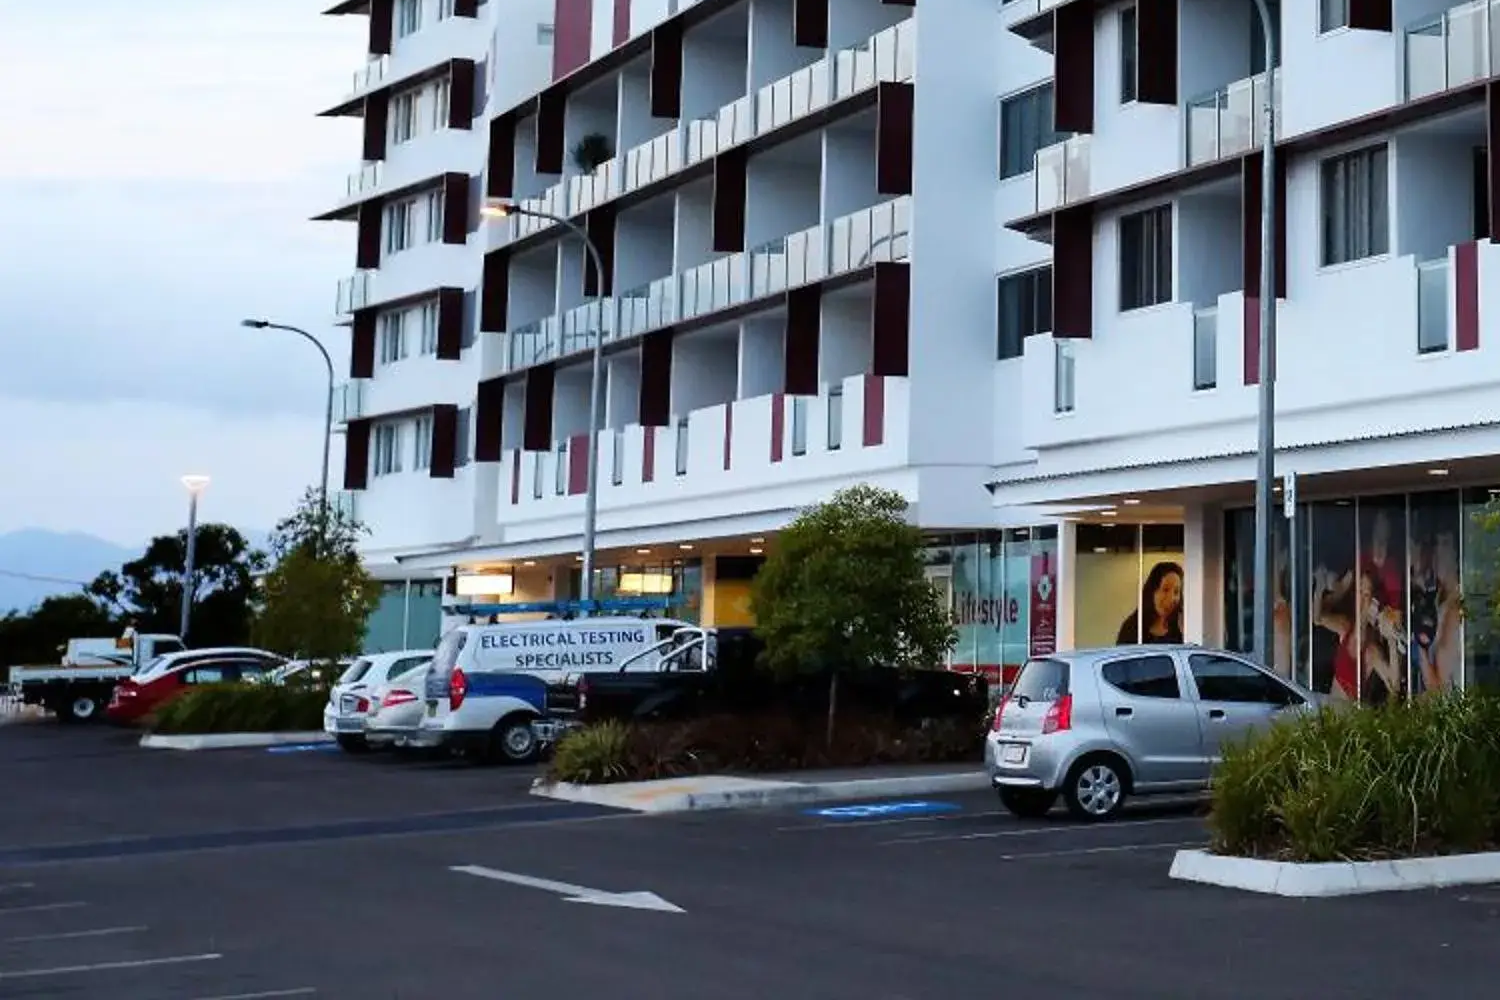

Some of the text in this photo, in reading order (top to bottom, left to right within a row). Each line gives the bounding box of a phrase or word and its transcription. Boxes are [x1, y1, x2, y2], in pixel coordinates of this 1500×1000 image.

[481, 629, 644, 649] ELECTRICAL TESTING
[515, 651, 613, 667] SPECIALISTS
